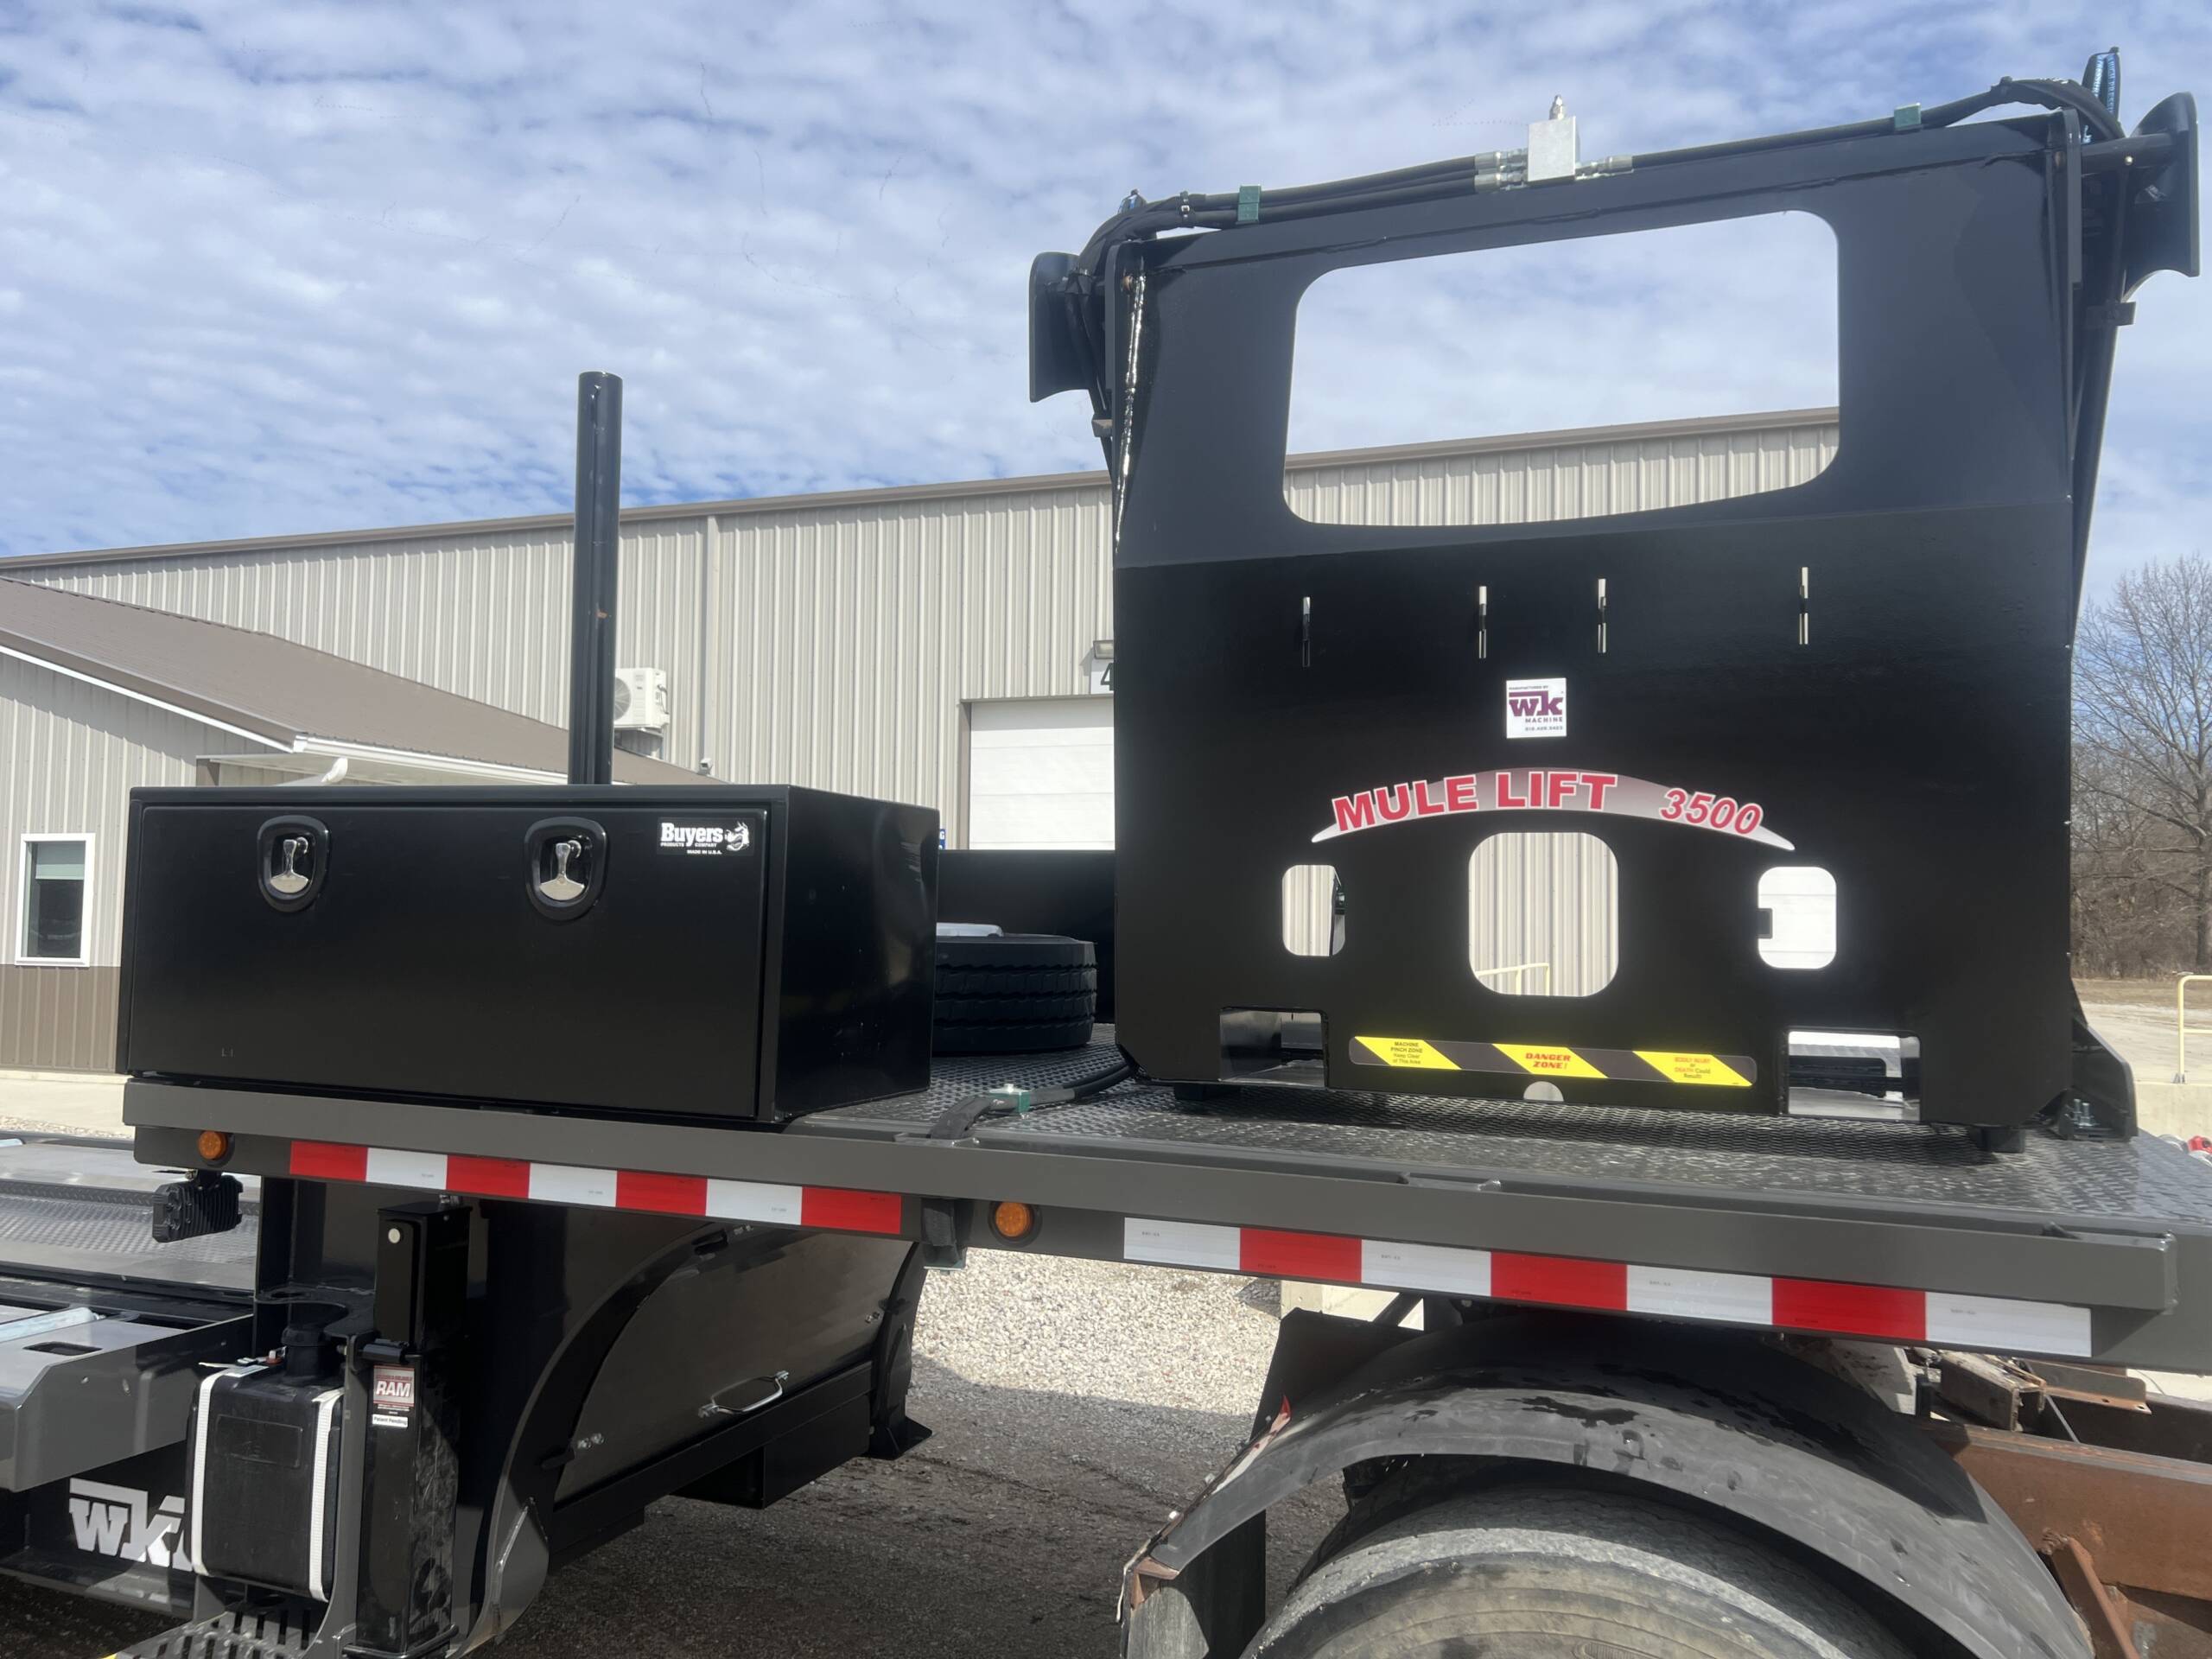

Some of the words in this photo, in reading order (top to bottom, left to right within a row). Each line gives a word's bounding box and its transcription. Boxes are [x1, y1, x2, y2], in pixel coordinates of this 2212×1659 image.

[1101, 662, 1115, 691] 4
[1332, 773, 1477, 834] MULE
[1496, 771, 1618, 811] LIFT
[1659, 786, 1764, 836] 3500
[660, 823, 724, 847] Buyers
[1525, 1052, 1571, 1062] DANGER
[1533, 1061, 1567, 1070] ZONE!
[376, 1380, 410, 1397] RAM
